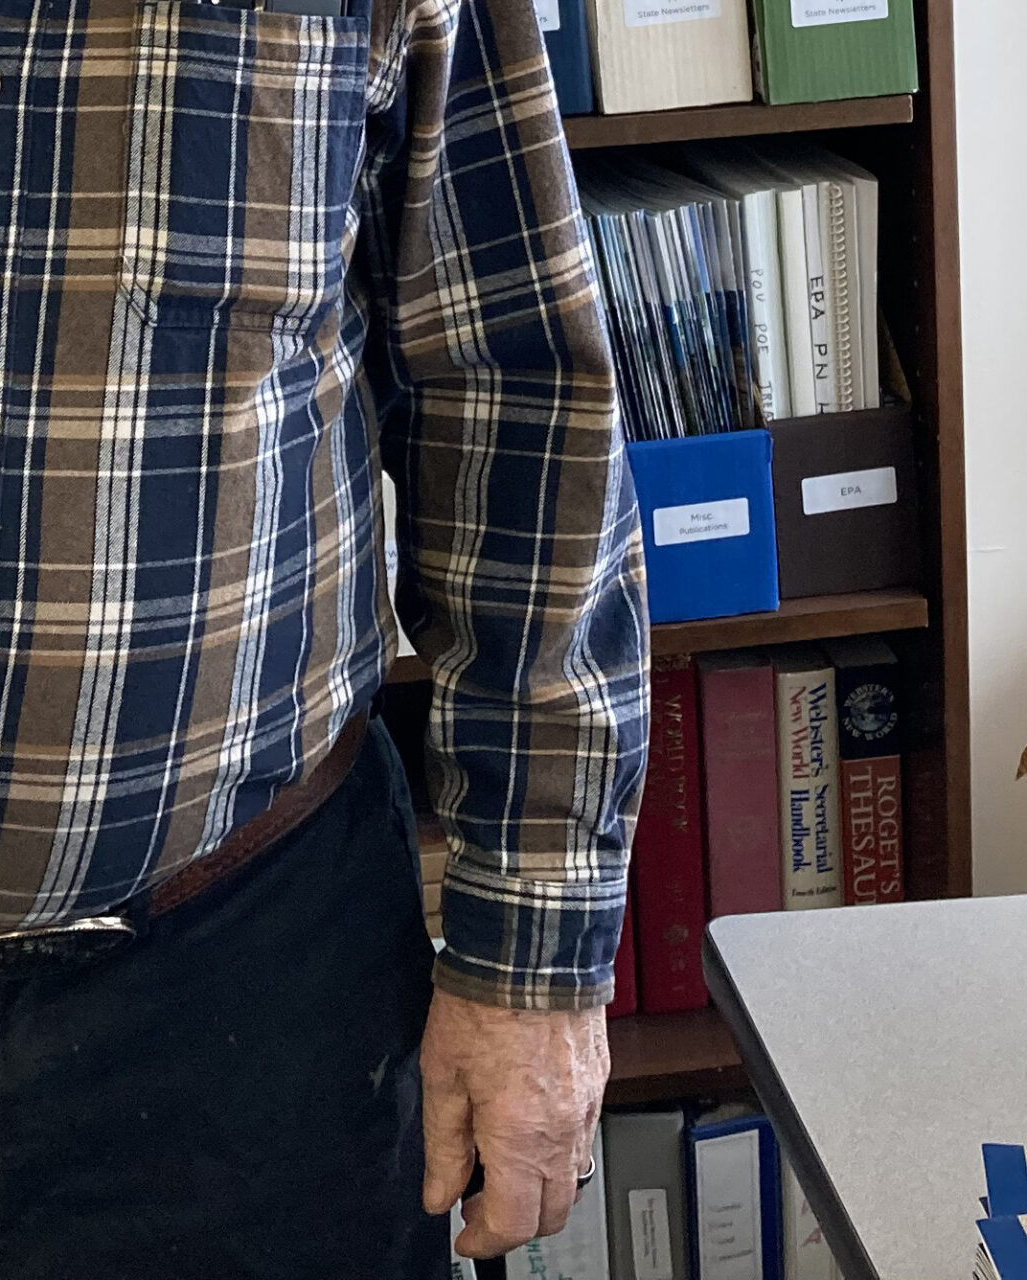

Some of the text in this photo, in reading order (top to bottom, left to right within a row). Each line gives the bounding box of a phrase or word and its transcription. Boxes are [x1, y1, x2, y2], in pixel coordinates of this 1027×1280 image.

[637, 3, 710, 19] State Newsletters
[804, 3, 877, 19] State Newsletters
[810, 276, 825, 320] EPA
[840, 486, 862, 497] EPA
[679, 523, 729, 537] Publications
[690, 513, 713, 522] Misc
[843, 683, 895, 707] WEBSTER'S
[864, 712, 898, 741] WORLD
[789, 686, 811, 873] New World Handbook
[809, 682, 833, 874] Webster's Secretarial
[849, 766, 877, 905] THESAU
[876, 775, 900, 895] ROGET'S
